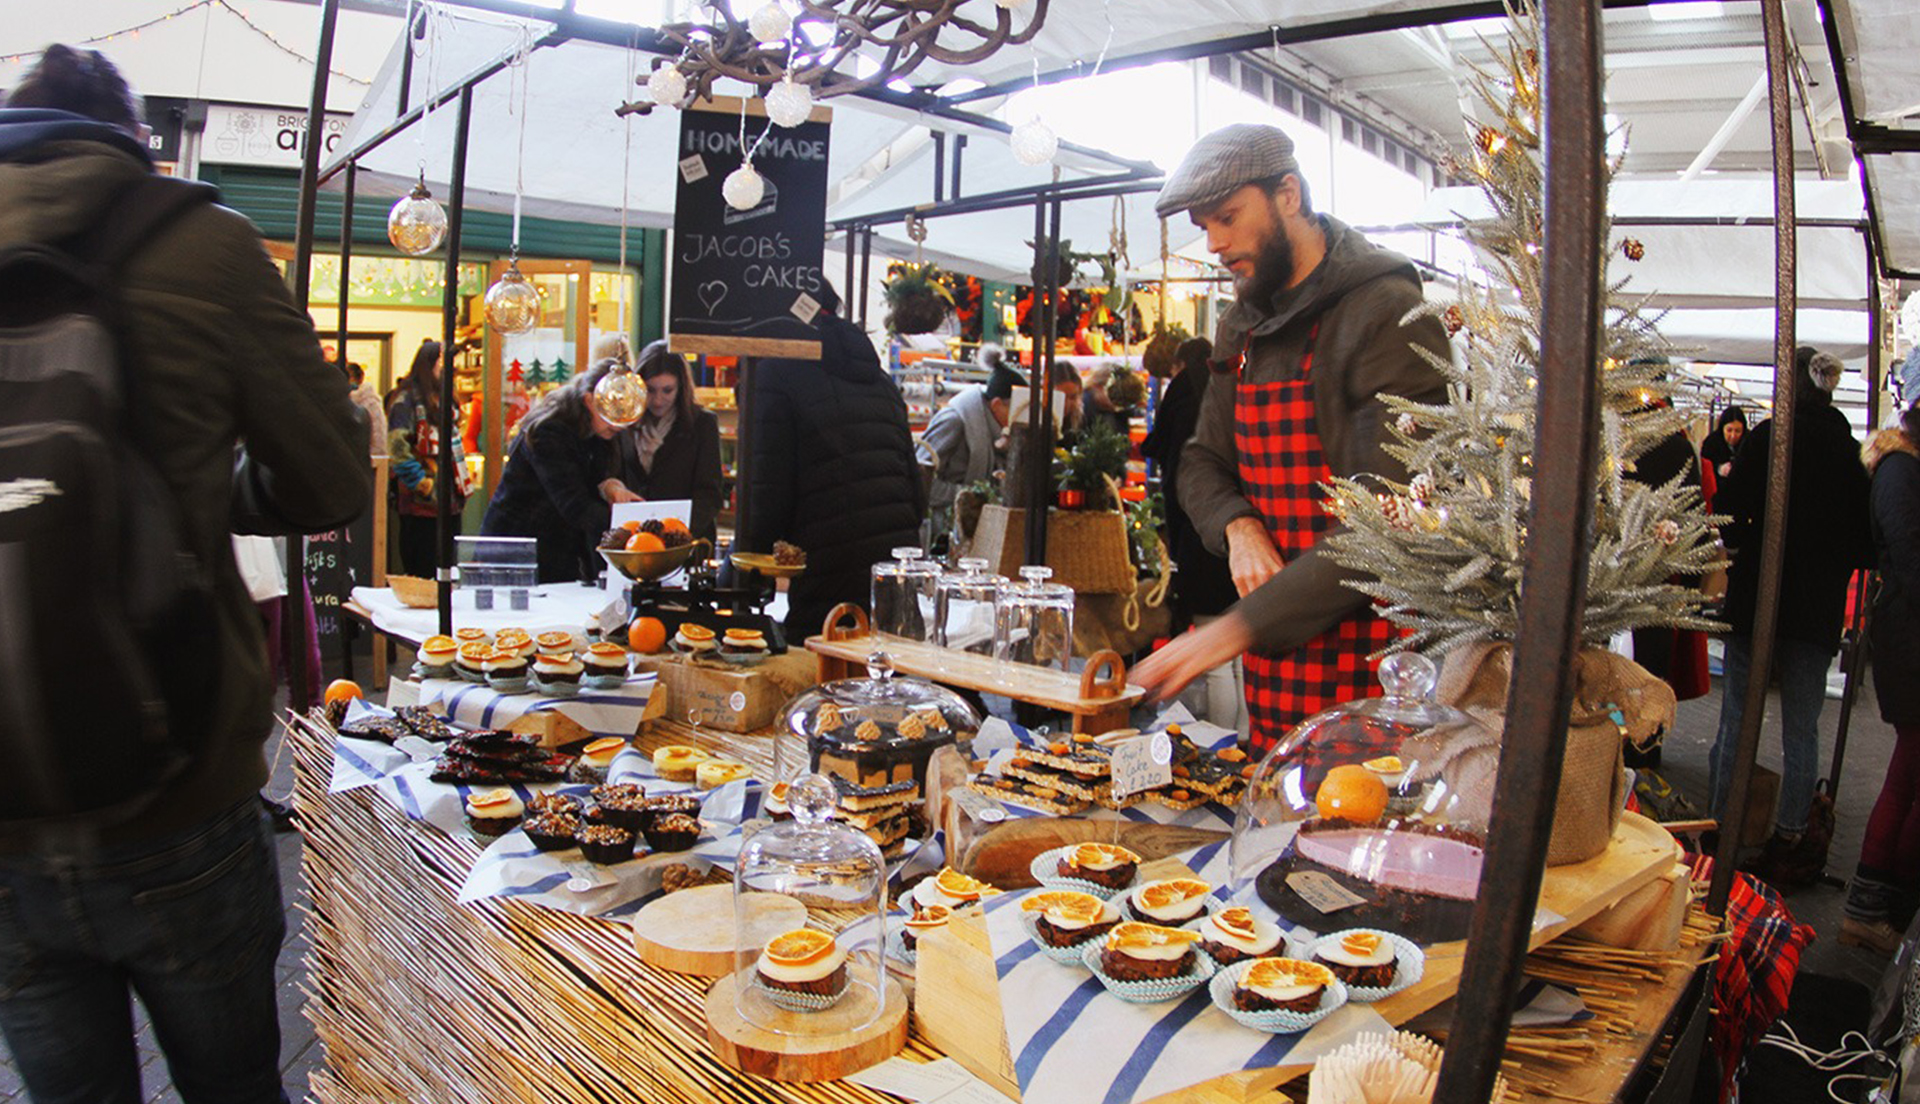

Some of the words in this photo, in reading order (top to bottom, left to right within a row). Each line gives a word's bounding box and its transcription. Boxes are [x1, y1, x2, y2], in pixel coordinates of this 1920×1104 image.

[686, 129, 826, 160] HOMEMADE
[682, 232, 792, 264] JACOB'S
[743, 264, 821, 293] CAKES
[1126, 759, 1149, 778] Cake
